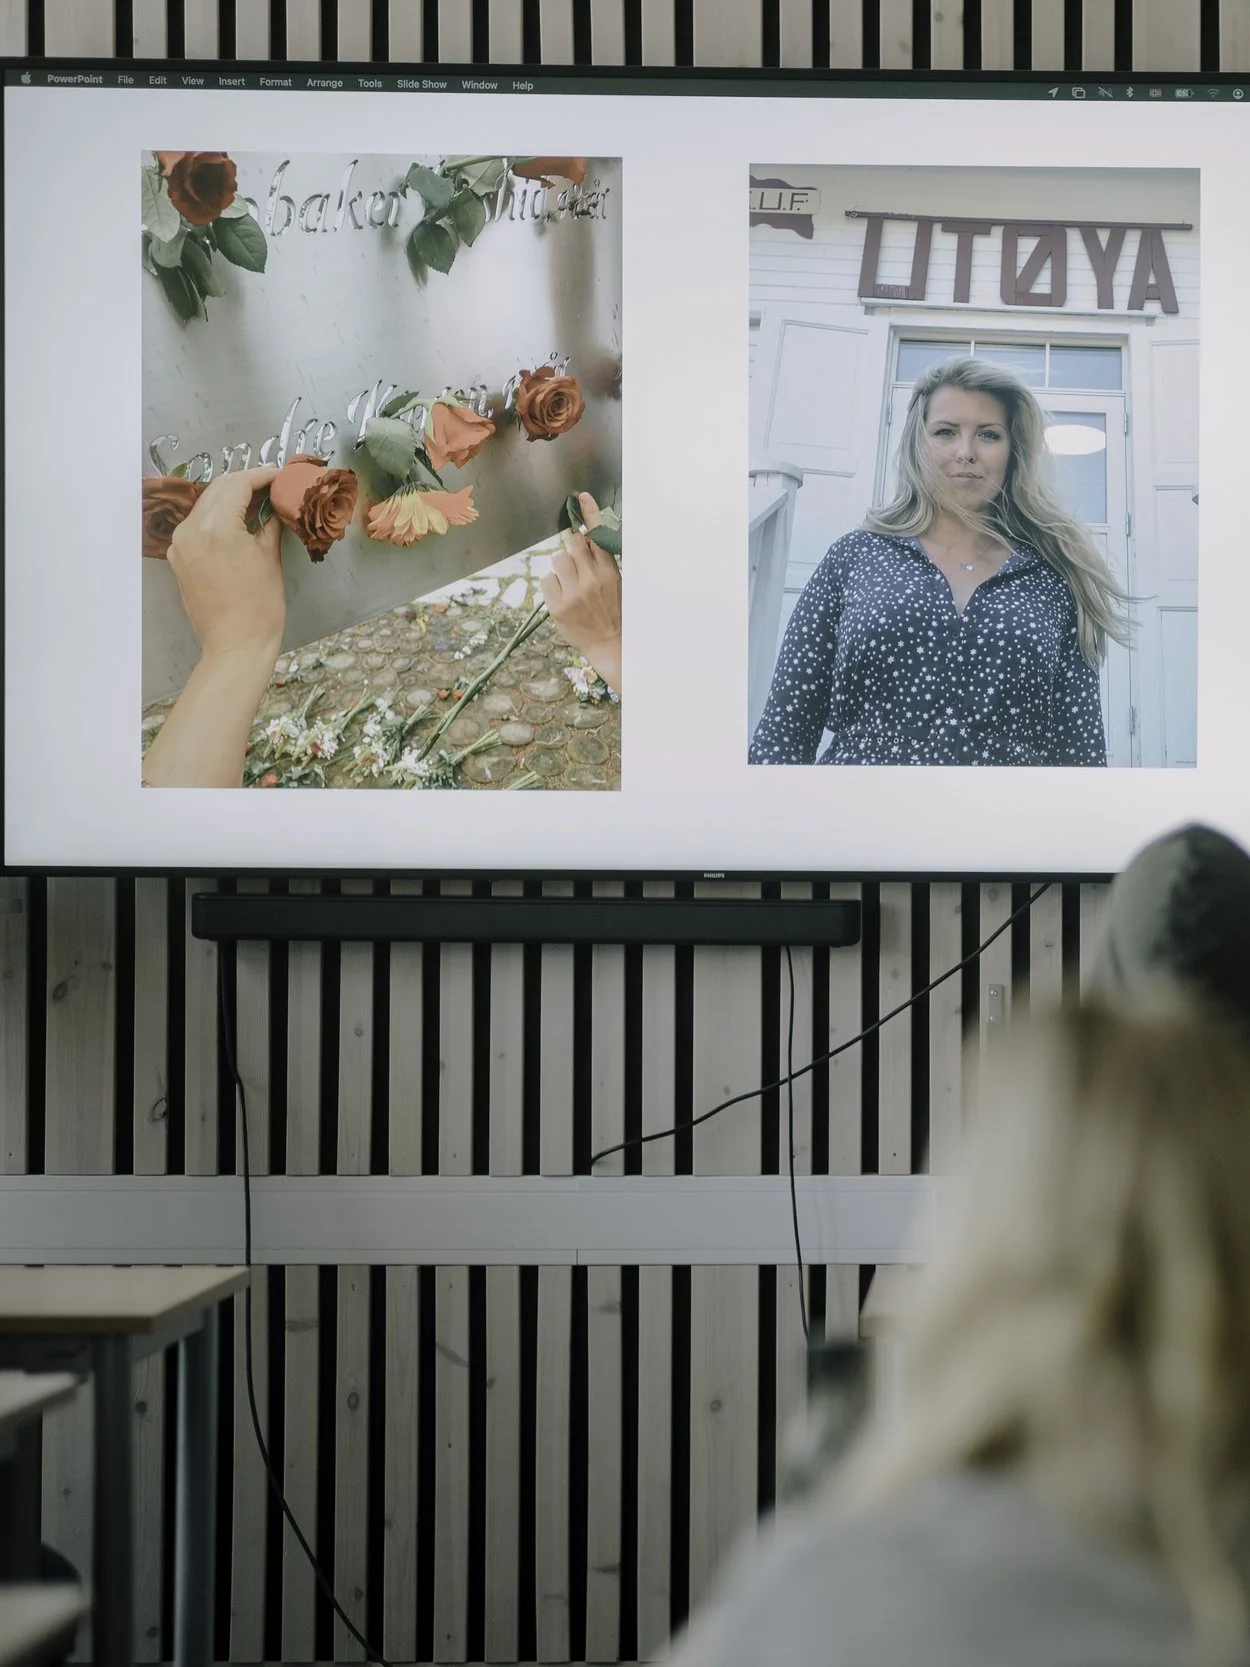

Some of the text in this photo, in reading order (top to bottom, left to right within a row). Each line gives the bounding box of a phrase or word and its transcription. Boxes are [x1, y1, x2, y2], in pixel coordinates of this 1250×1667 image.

[47, 74, 103, 84] PowerPoint
[118, 75, 134, 85] File
[149, 76, 167, 85] Edit
[182, 76, 204, 85] View
[219, 77, 246, 86] Insert
[259, 77, 293, 87] Format
[306, 78, 344, 88] Arrange
[357, 79, 383, 88] Tools
[397, 79, 447, 89] Slide Show
[461, 80, 498, 90] Window
[512, 81, 534, 91] Help
[749, 191, 809, 211] .U.F.
[857, 218, 1180, 313] UTØYA
